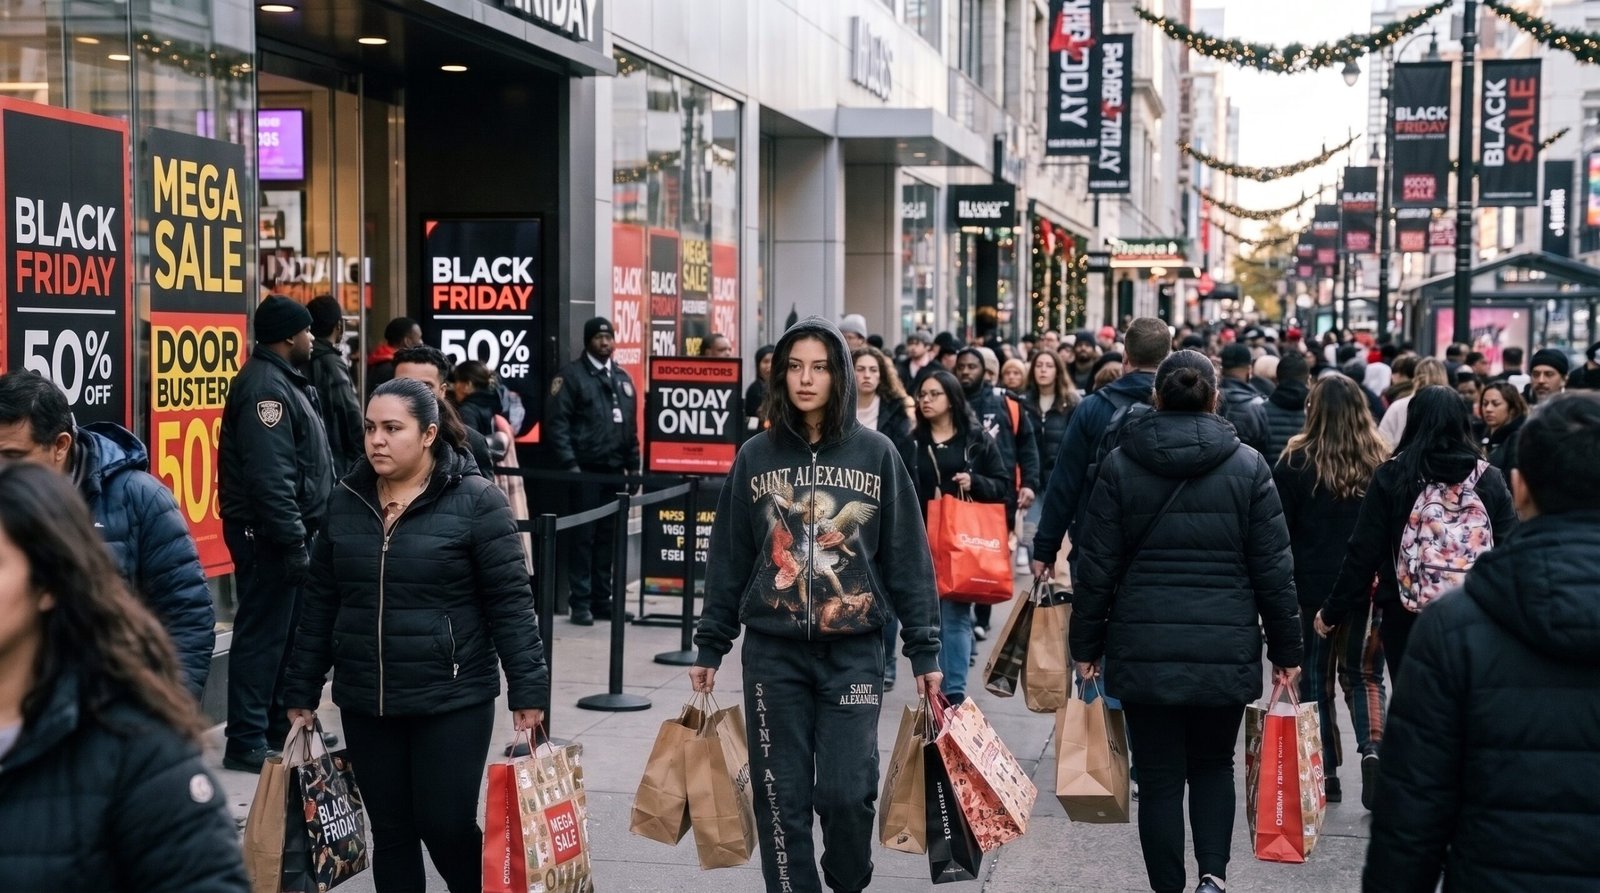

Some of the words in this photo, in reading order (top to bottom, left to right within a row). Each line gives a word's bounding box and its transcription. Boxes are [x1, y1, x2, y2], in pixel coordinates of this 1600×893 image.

[1395, 106, 1448, 121] BLACK
[1395, 120, 1448, 133] FRIDAY
[1483, 78, 1507, 167] BLACK
[1507, 77, 1535, 163] SALE
[153, 154, 243, 223] MEGA
[15, 196, 117, 251] BLACK
[155, 219, 243, 294] SALE
[683, 239, 708, 264] MEGA
[16, 250, 116, 296] FRIDAY
[432, 256, 534, 284] BLACK
[613, 266, 642, 295] BLACK
[651, 270, 677, 295] BLACK
[683, 263, 708, 292] SALE
[432, 285, 534, 311] FRIDAY
[713, 276, 736, 302] BLACK
[614, 300, 642, 344] 50%
[157, 330, 239, 374] DOOR
[440, 329, 530, 372] 50%
[652, 330, 677, 357] 50%
[500, 363, 529, 379] OFF
[84, 385, 111, 406] OFF
[658, 387, 733, 409] TODAY
[658, 408, 730, 436] ONLY
[750, 468, 791, 504] SAINT
[793, 466, 882, 502] ALEXANDER
[839, 694, 879, 706] ALEXANDER
[850, 683, 873, 695] SAINT
[754, 683, 770, 759] SAINT
[763, 769, 793, 893] ALEXANDER
[317, 794, 352, 825] BLACK
[550, 811, 574, 832] MEGA
[322, 813, 357, 844] FRIDAY
[554, 830, 578, 853] SALE
